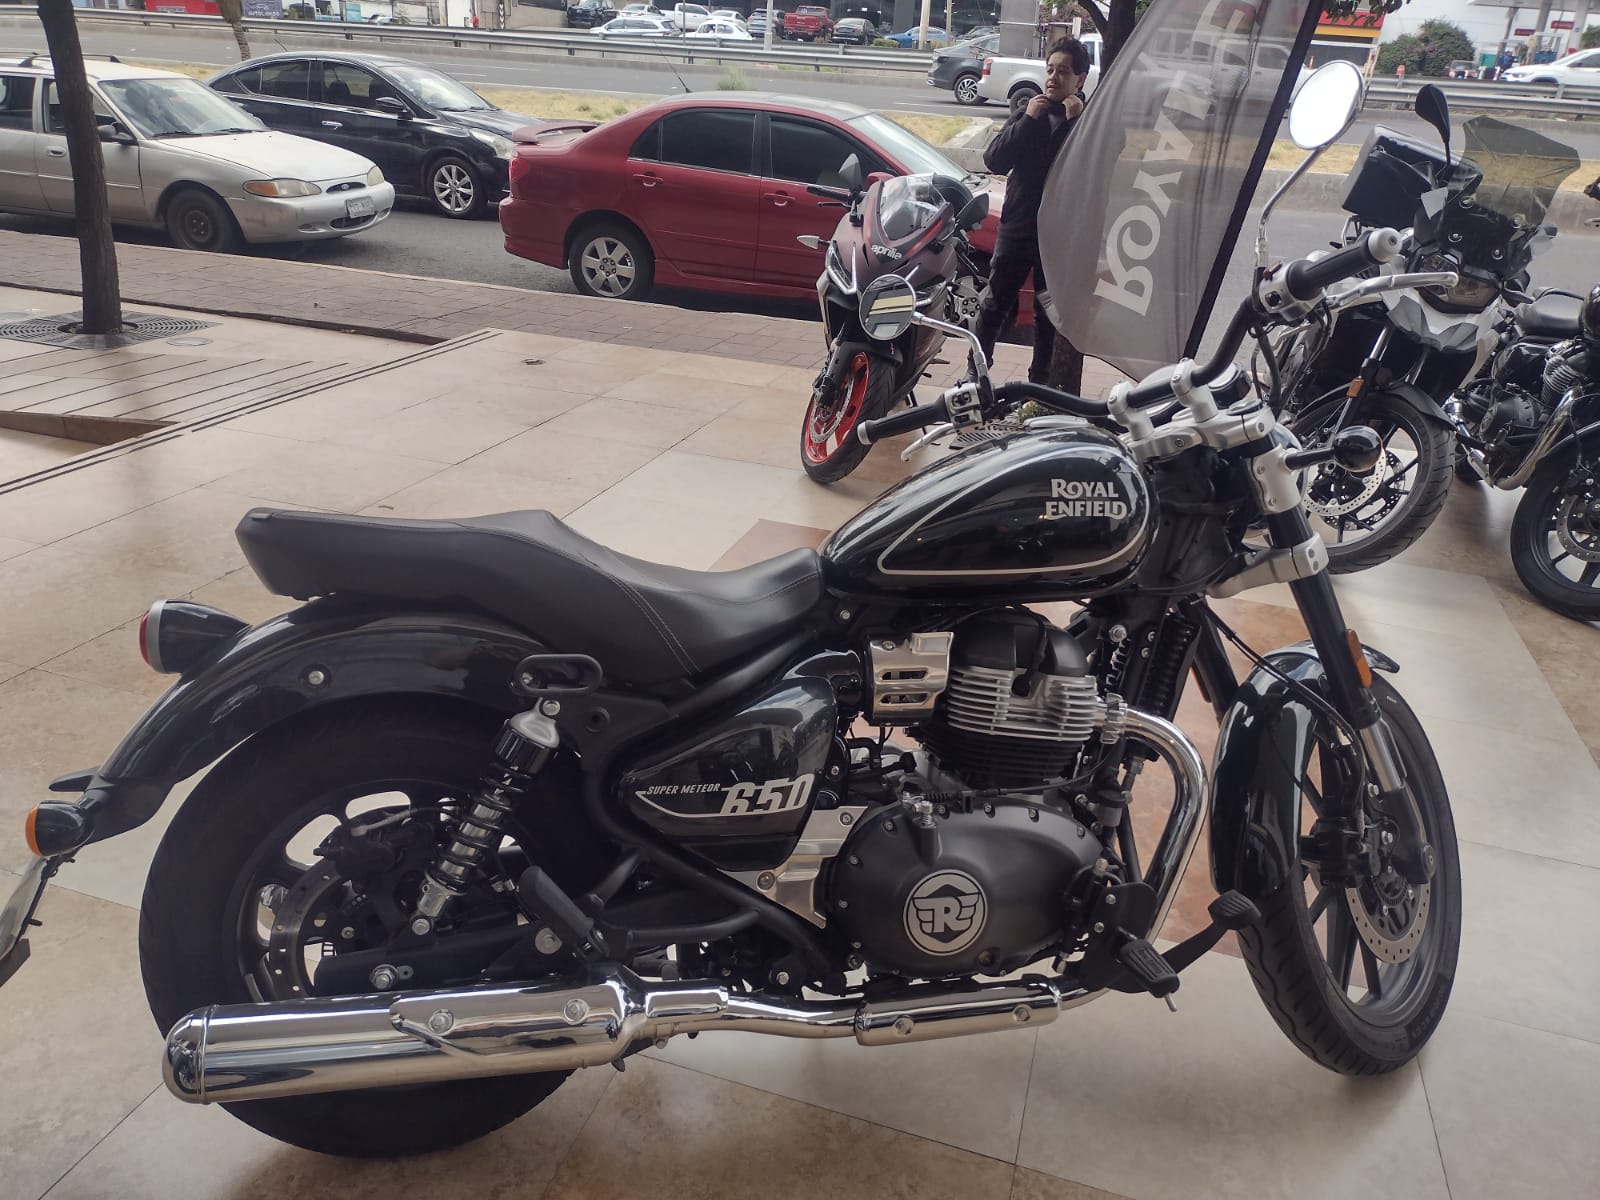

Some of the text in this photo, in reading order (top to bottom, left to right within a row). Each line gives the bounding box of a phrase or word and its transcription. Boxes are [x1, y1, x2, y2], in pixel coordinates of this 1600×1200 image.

[871, 244, 902, 259] aprilia
[1051, 478, 1119, 498] ROYAL
[1045, 501, 1127, 520] ENFIELD
[647, 773, 815, 816] SUPER METEOR 650
